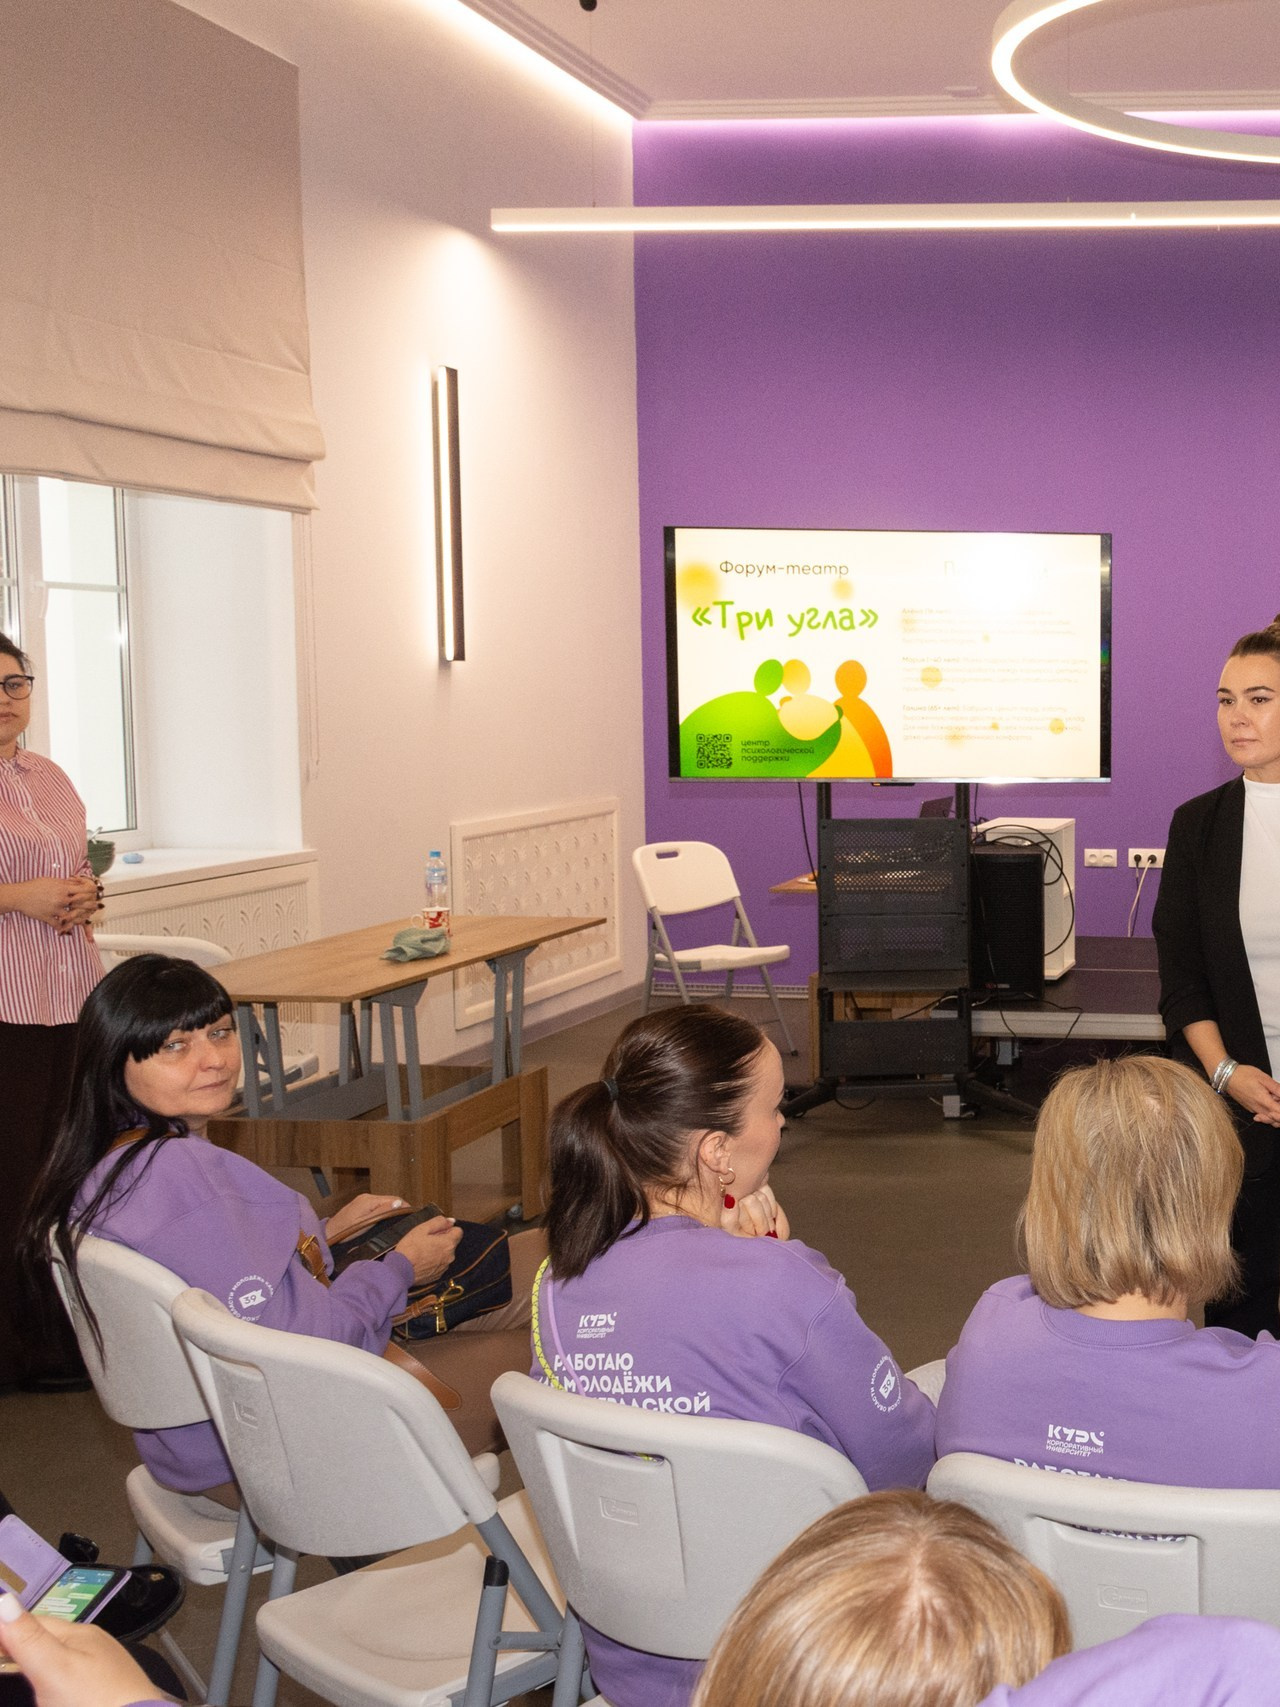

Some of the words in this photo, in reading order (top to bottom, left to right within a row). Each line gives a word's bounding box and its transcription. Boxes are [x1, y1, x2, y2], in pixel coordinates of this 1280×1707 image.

[719, 560, 849, 579] Форум-театр
[692, 601, 774, 641] «Три
[787, 607, 879, 637] угла»
[741, 747, 815, 755] психологической
[741, 755, 790, 763] поддержки
[243, 1294, 257, 1305] 39
[554, 1353, 634, 1371] РАБОТАЮ
[564, 1371, 672, 1393] МОЛОДЁЖИ
[1045, 1444, 1091, 1457] УНИВЕРСИТЕТ
[1046, 1439, 1104, 1454] КОРПОРАТИВНЫЙ
